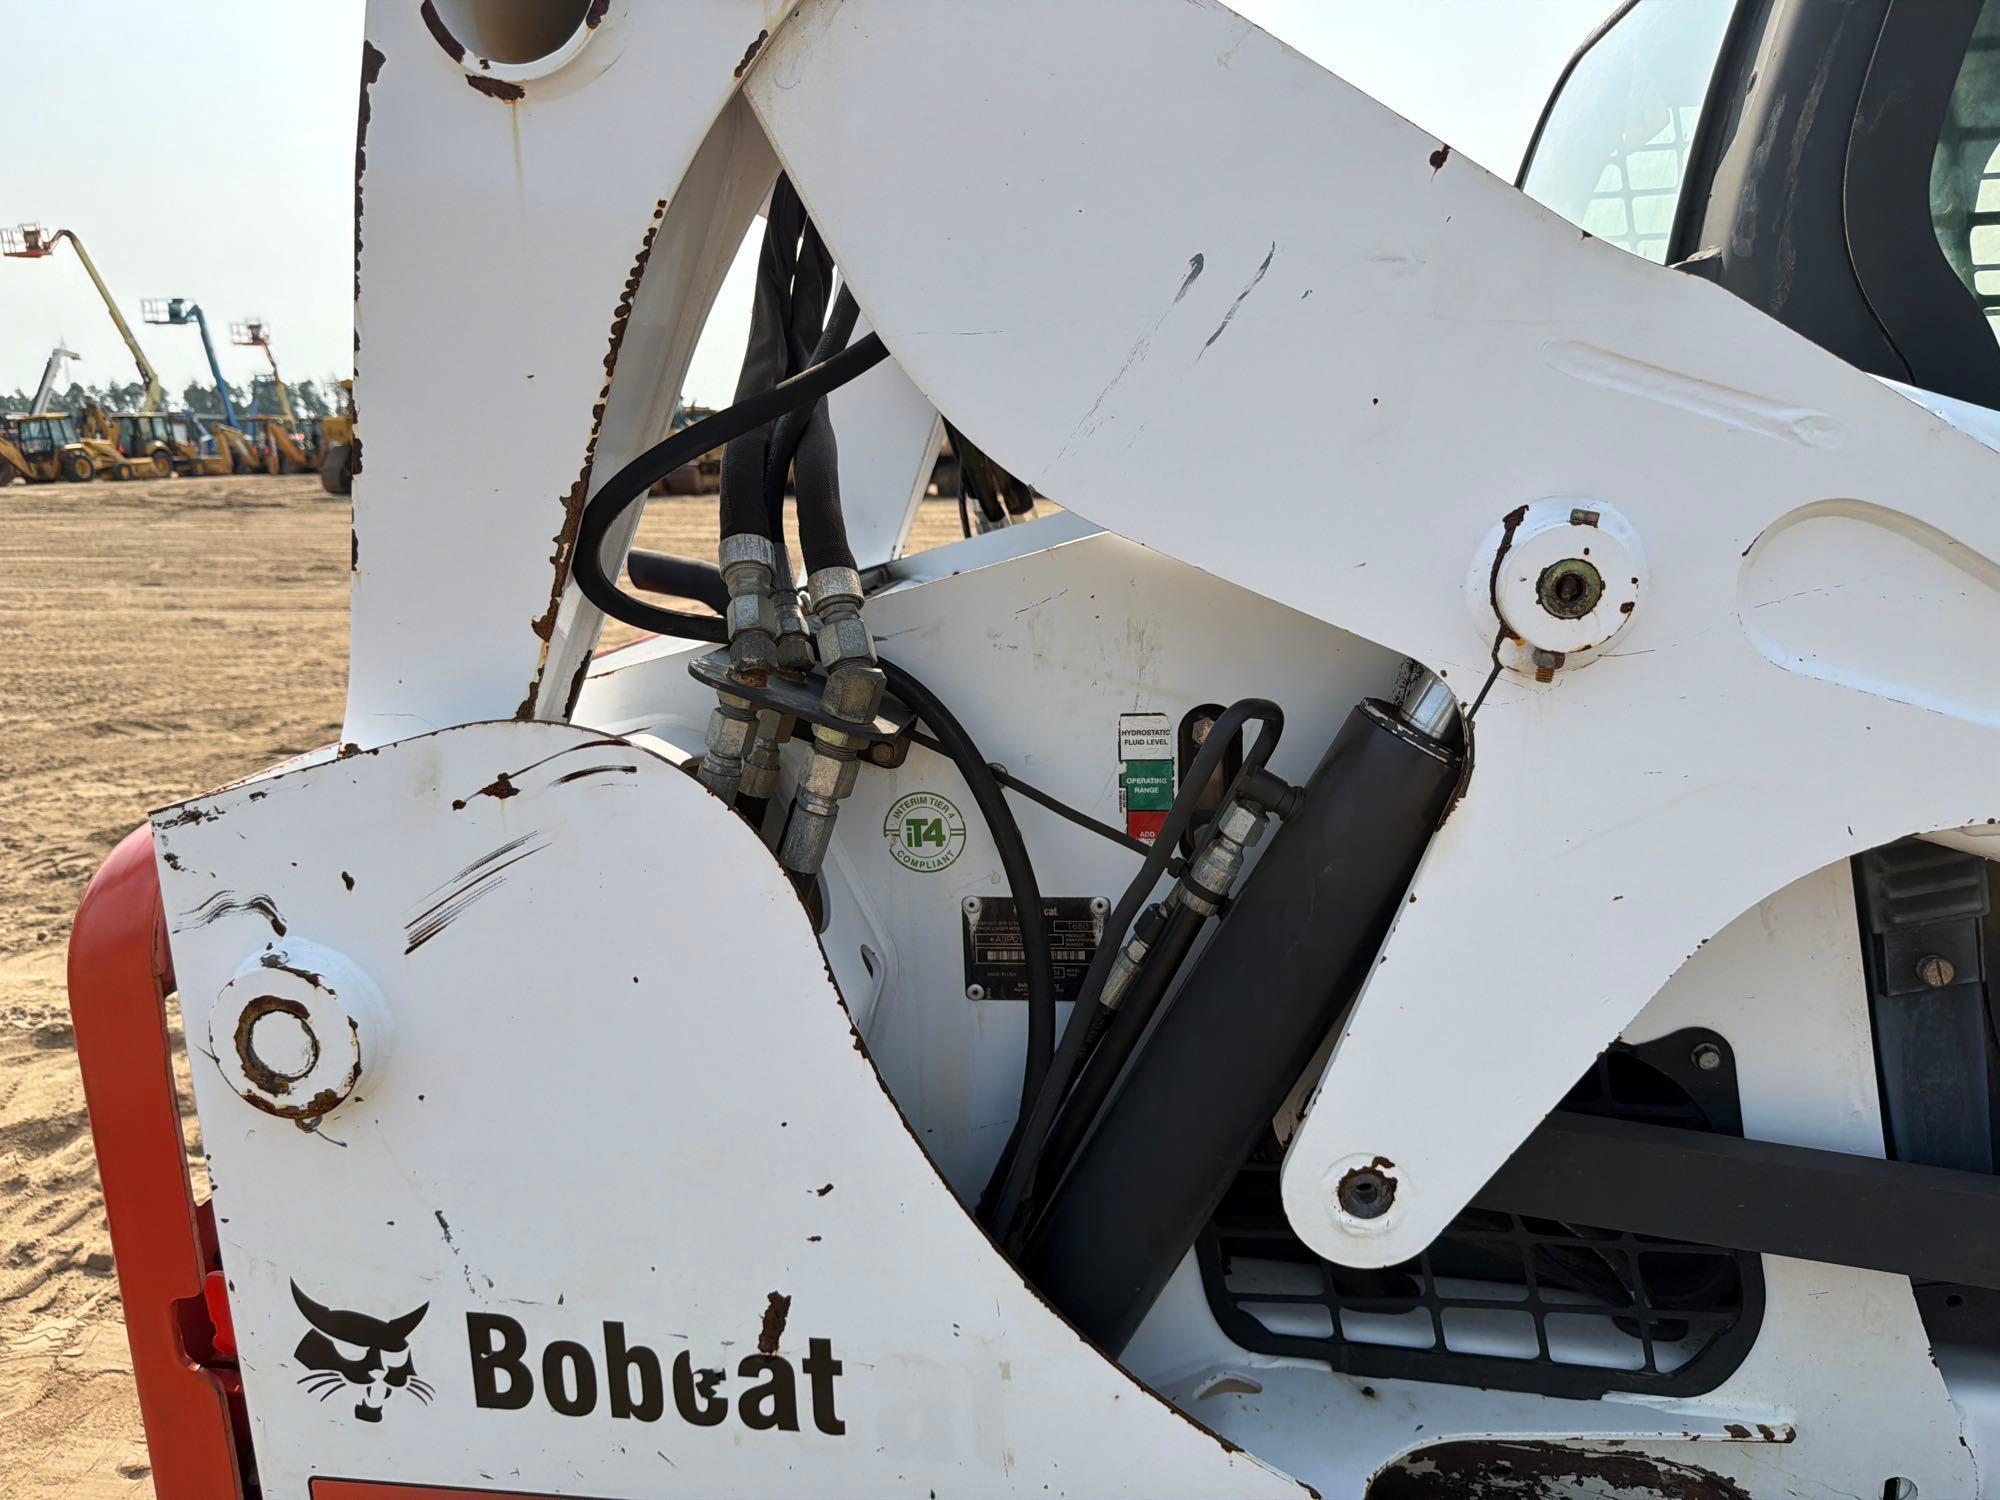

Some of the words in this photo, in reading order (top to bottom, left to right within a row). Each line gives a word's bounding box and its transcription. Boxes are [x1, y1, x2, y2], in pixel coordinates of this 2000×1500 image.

[1126, 777, 1168, 785] OPERATING
[1134, 786, 1160, 794] RANGE
[893, 796, 928, 819] INTERIM
[929, 797, 950, 813] TIER
[905, 817, 947, 848] iT4
[896, 849, 955, 869] COMPLIANT
[466, 1311, 846, 1436] Bobcat
